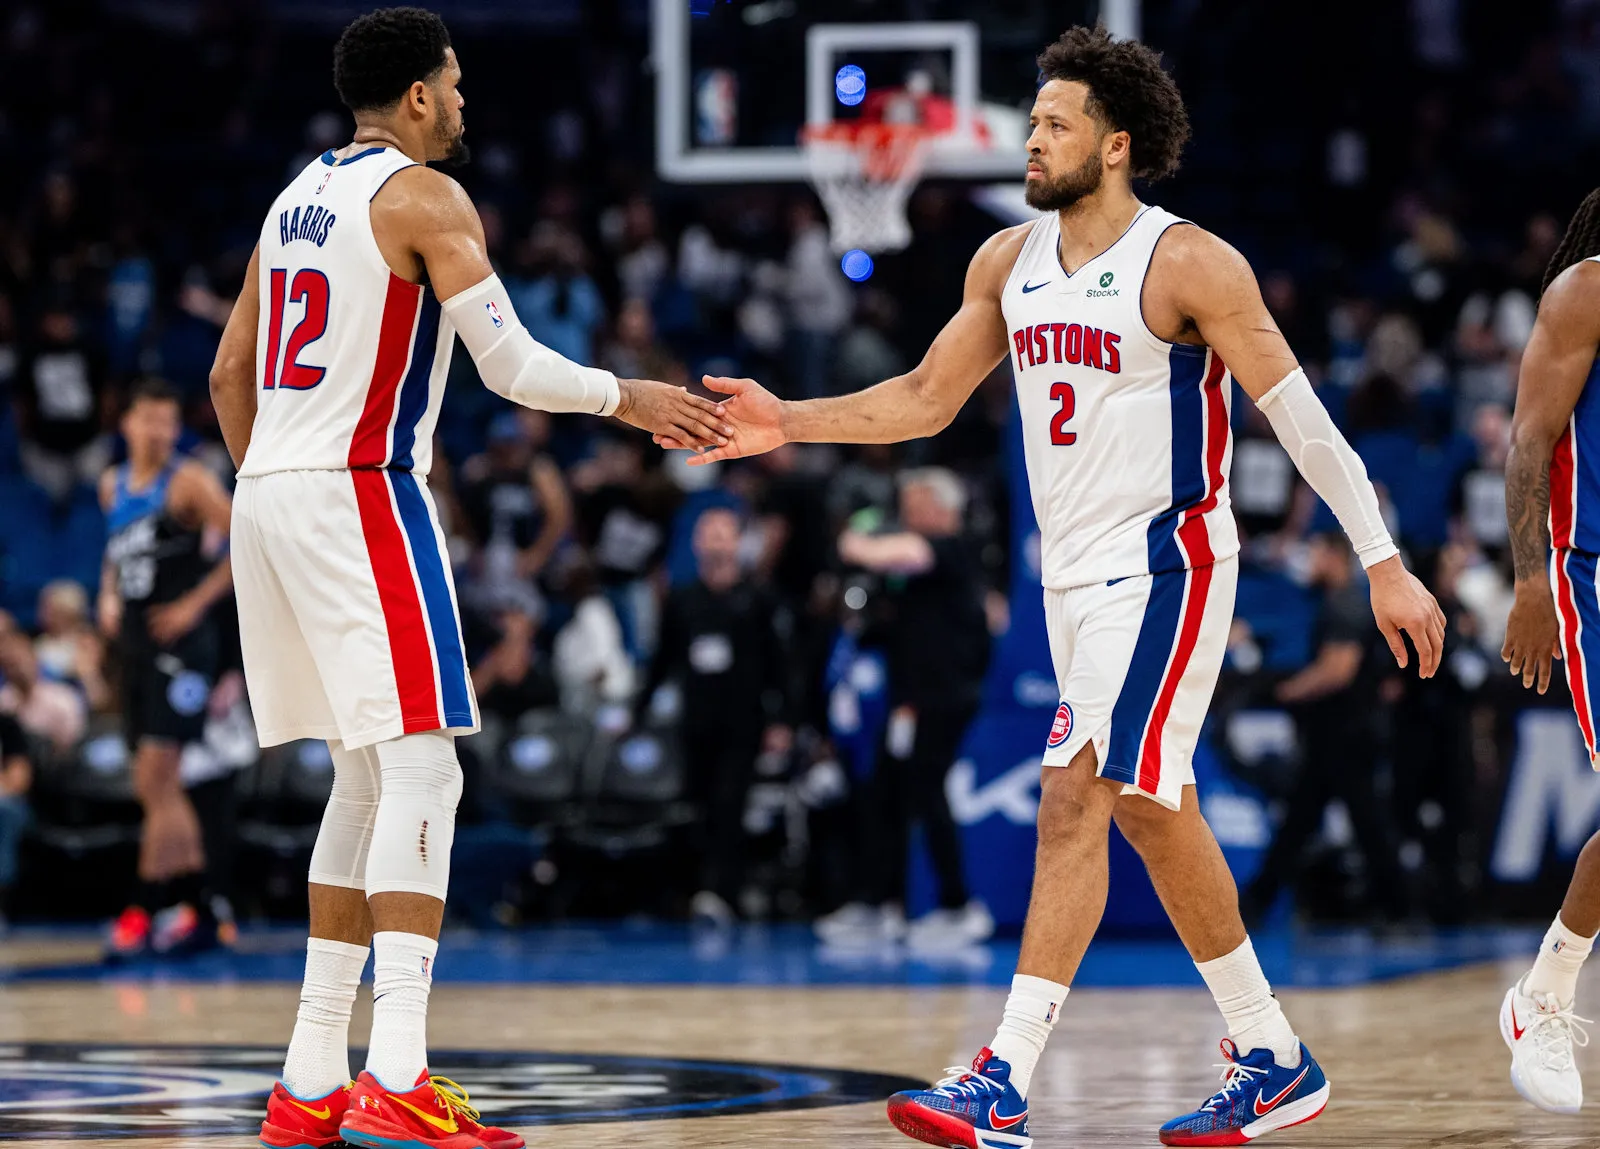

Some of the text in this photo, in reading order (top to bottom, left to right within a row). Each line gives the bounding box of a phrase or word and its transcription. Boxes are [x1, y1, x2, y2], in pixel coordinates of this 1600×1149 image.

[280, 205, 336, 248] HARRIS
[1086, 289, 1119, 298] StockX
[263, 268, 330, 390] 12
[1013, 323, 1121, 374] PISTONS
[1050, 382, 1077, 446] 2
